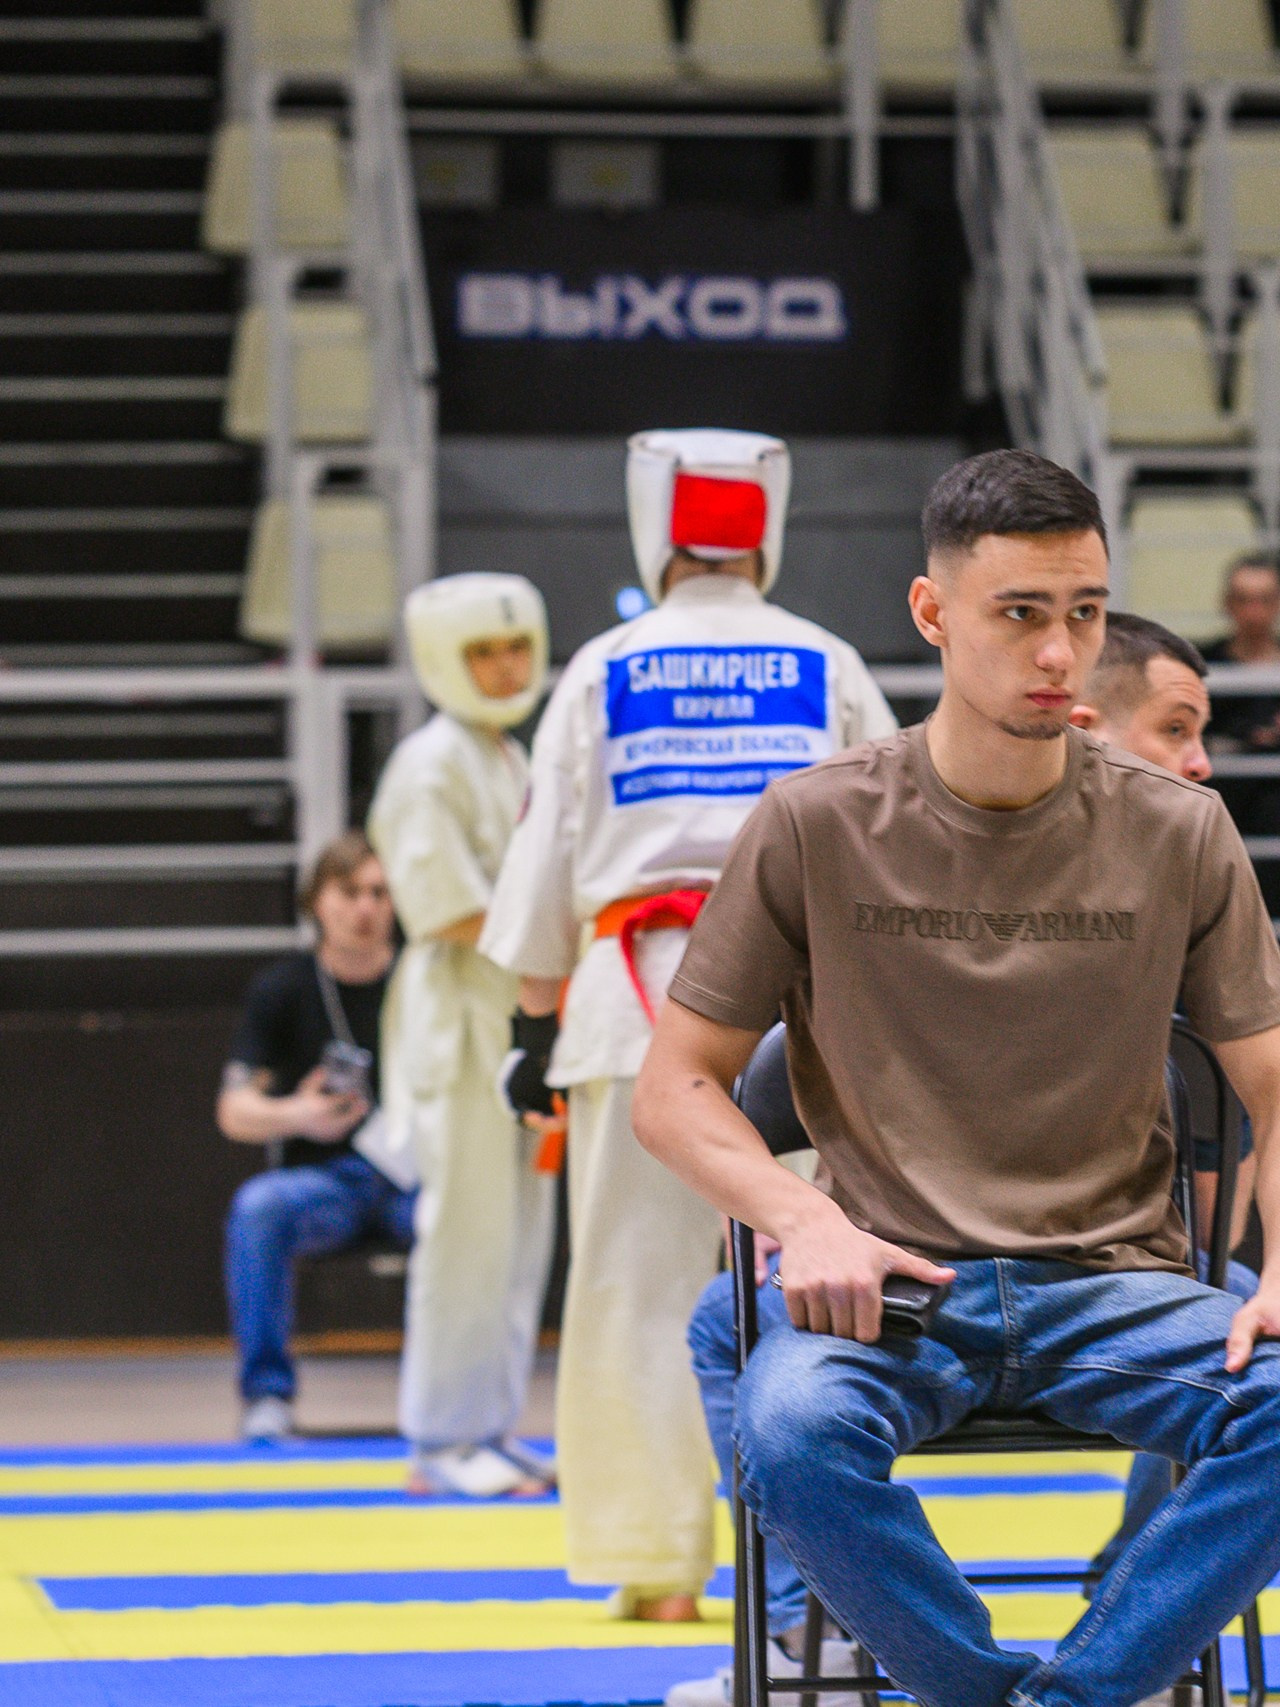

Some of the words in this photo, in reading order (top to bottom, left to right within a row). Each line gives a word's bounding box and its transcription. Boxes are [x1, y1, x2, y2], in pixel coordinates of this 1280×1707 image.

[457, 270, 847, 342] ВЫХОД
[627, 653, 799, 692] БАШКИРЦЕВ
[853, 901, 982, 942] EMPORIO
[1019, 911, 1136, 942] ARMANI
